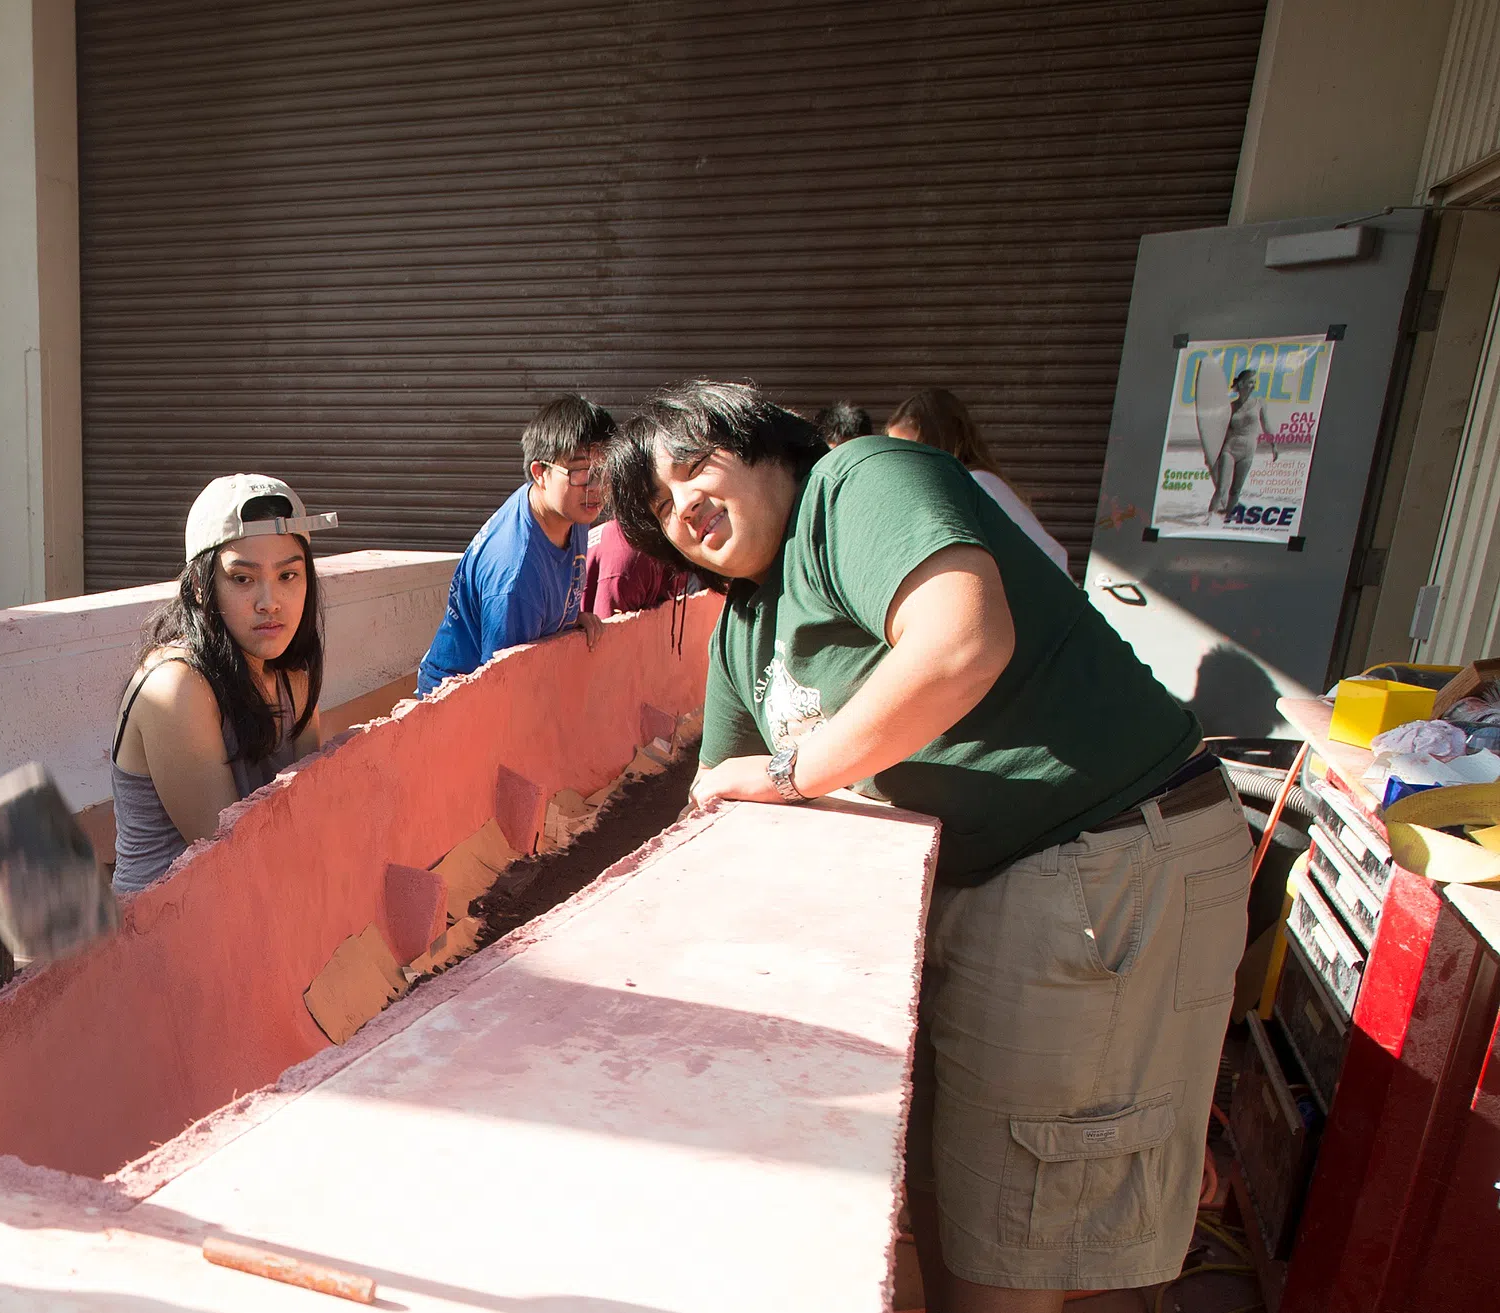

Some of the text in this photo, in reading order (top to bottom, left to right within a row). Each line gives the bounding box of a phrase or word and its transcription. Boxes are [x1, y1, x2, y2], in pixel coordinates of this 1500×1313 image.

[1290, 412, 1316, 423] CAL
[1279, 423, 1315, 434] POLY
[1257, 432, 1312, 445] POMONA
[1297, 461, 1306, 469] to
[1163, 469, 1210, 480] Concrete
[1250, 469, 1305, 478] goodness it's
[1162, 480, 1193, 491] Canoe
[1250, 477, 1303, 486] the absolute
[1224, 503, 1297, 526] ASCE
[754, 677, 770, 704] CAL
[1086, 1130, 1116, 1139] Wrangler
